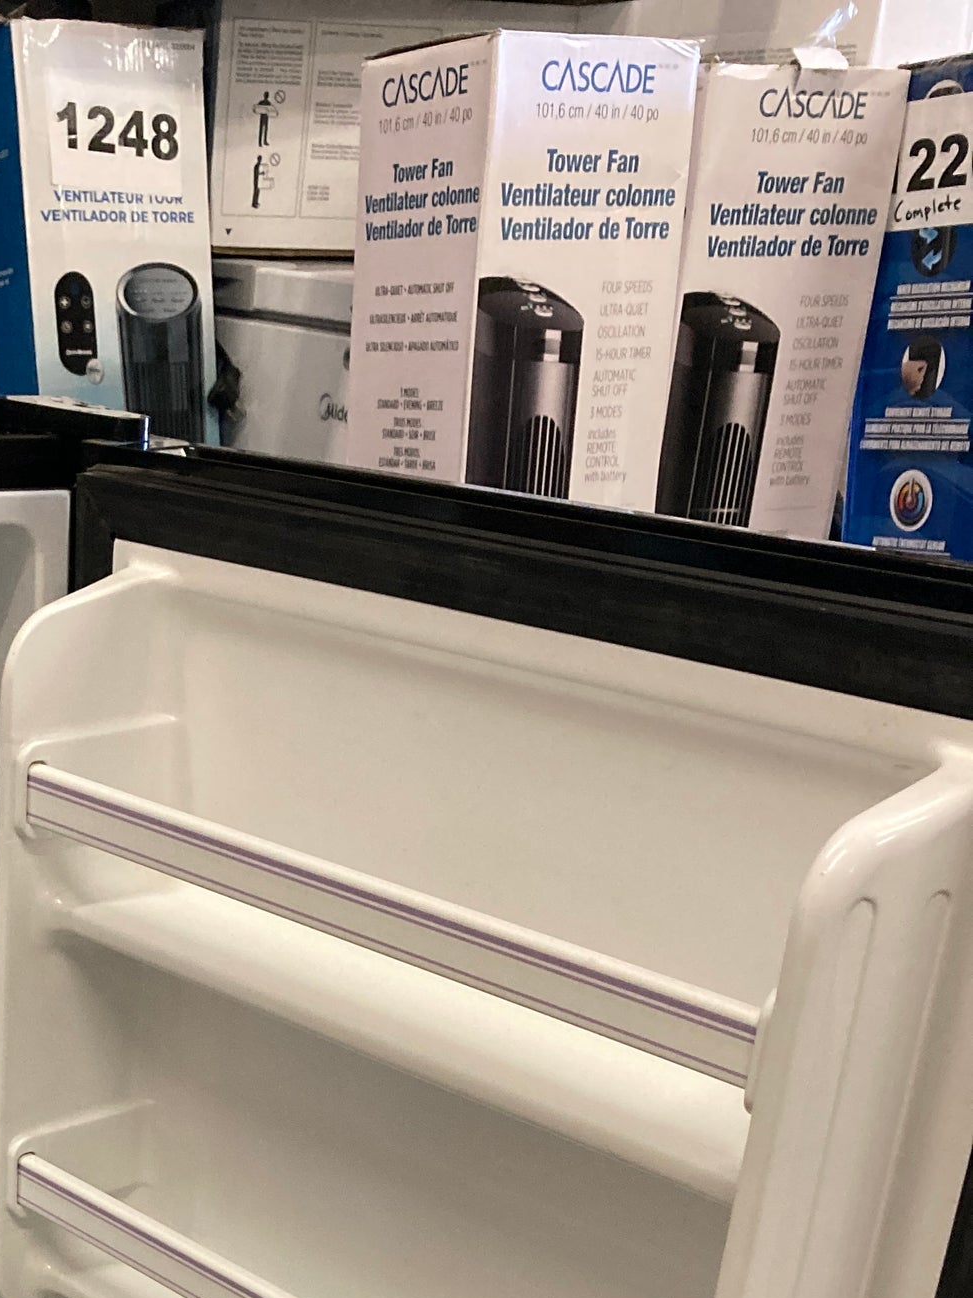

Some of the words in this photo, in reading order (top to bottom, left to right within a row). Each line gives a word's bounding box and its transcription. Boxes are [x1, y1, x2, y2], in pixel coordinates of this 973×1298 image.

[382, 64, 468, 108] CASCADE
[542, 57, 656, 94] CASCADE
[536, 102, 565, 120] 101,6
[568, 105, 584, 118] cm
[594, 104, 608, 119] 40
[611, 104, 620, 119] in
[630, 104, 644, 120] 40
[646, 107, 658, 122] po
[760, 86, 868, 119] CASCADE
[422, 112, 432, 128] 40
[450, 106, 460, 122] 40
[56, 102, 178, 160] 1248
[782, 130, 797, 143] cm
[806, 129, 820, 144] 40
[822, 130, 830, 144] in
[840, 130, 854, 144] 40
[856, 132, 868, 146] po
[393, 163, 428, 184] Tower
[431, 158, 454, 178] Fan
[547, 148, 601, 173] Tower
[606, 149, 639, 173] Fan
[892, 133, 973, 194] 22
[757, 171, 809, 194] Tower
[812, 172, 844, 194] Fan
[54, 190, 144, 204] VENTILATEUR
[365, 192, 428, 214] Ventilateur
[432, 186, 480, 208] colonne
[500, 182, 600, 207] Ventilateur
[606, 184, 676, 206] colonne
[40, 210, 126, 222] VENTILADOR
[131, 210, 148, 222] DE
[153, 210, 195, 224] TORRE
[710, 204, 806, 226] Ventilateur
[810, 204, 878, 226] colonne
[894, 194, 962, 222] Complete
[366, 218, 424, 242] Ventilador
[428, 216, 442, 236] de
[446, 214, 477, 235] Torre
[500, 216, 594, 241] Ventilador
[599, 217, 620, 240] de
[626, 216, 670, 240] Torre
[708, 235, 796, 258] Ventilador
[801, 235, 822, 257] de
[828, 235, 870, 256] Torre
[602, 280, 622, 294] FOUR
[624, 280, 654, 294] SPEEDS
[597, 325, 646, 339] OSCILLATION
[628, 346, 652, 360] TIMER
[594, 368, 636, 382] AUTOMATIC
[592, 384, 610, 398] SHUT
[612, 383, 628, 397] OFF
[596, 405, 622, 418] MODES
[587, 441, 616, 454] REMOTE
[586, 455, 618, 468] CONTROL
